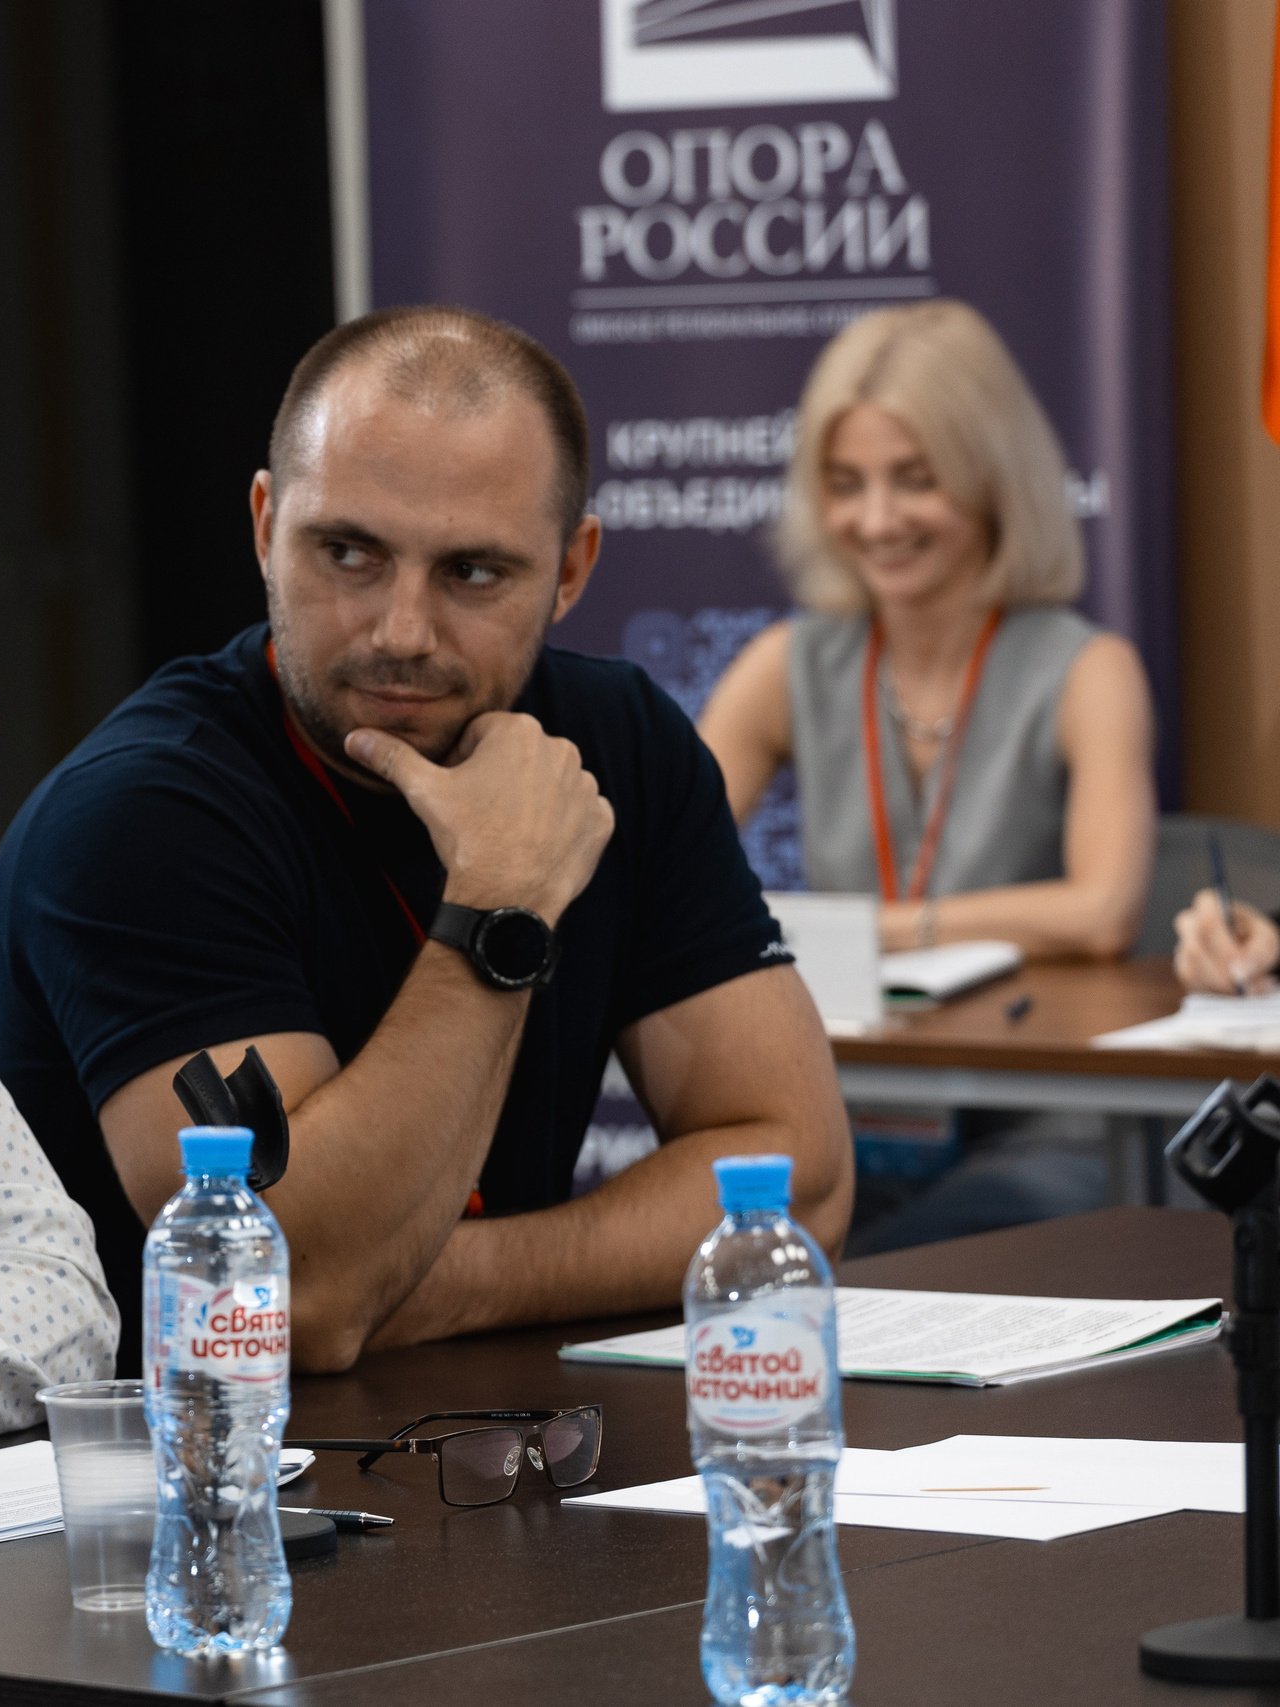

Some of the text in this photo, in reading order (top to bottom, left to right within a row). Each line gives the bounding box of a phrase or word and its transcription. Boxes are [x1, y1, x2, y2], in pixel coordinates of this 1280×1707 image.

[600, 119, 907, 207] ОПОРА
[576, 195, 931, 281] РОССИИ
[606, 408, 795, 470] КРУПНЕЙ
